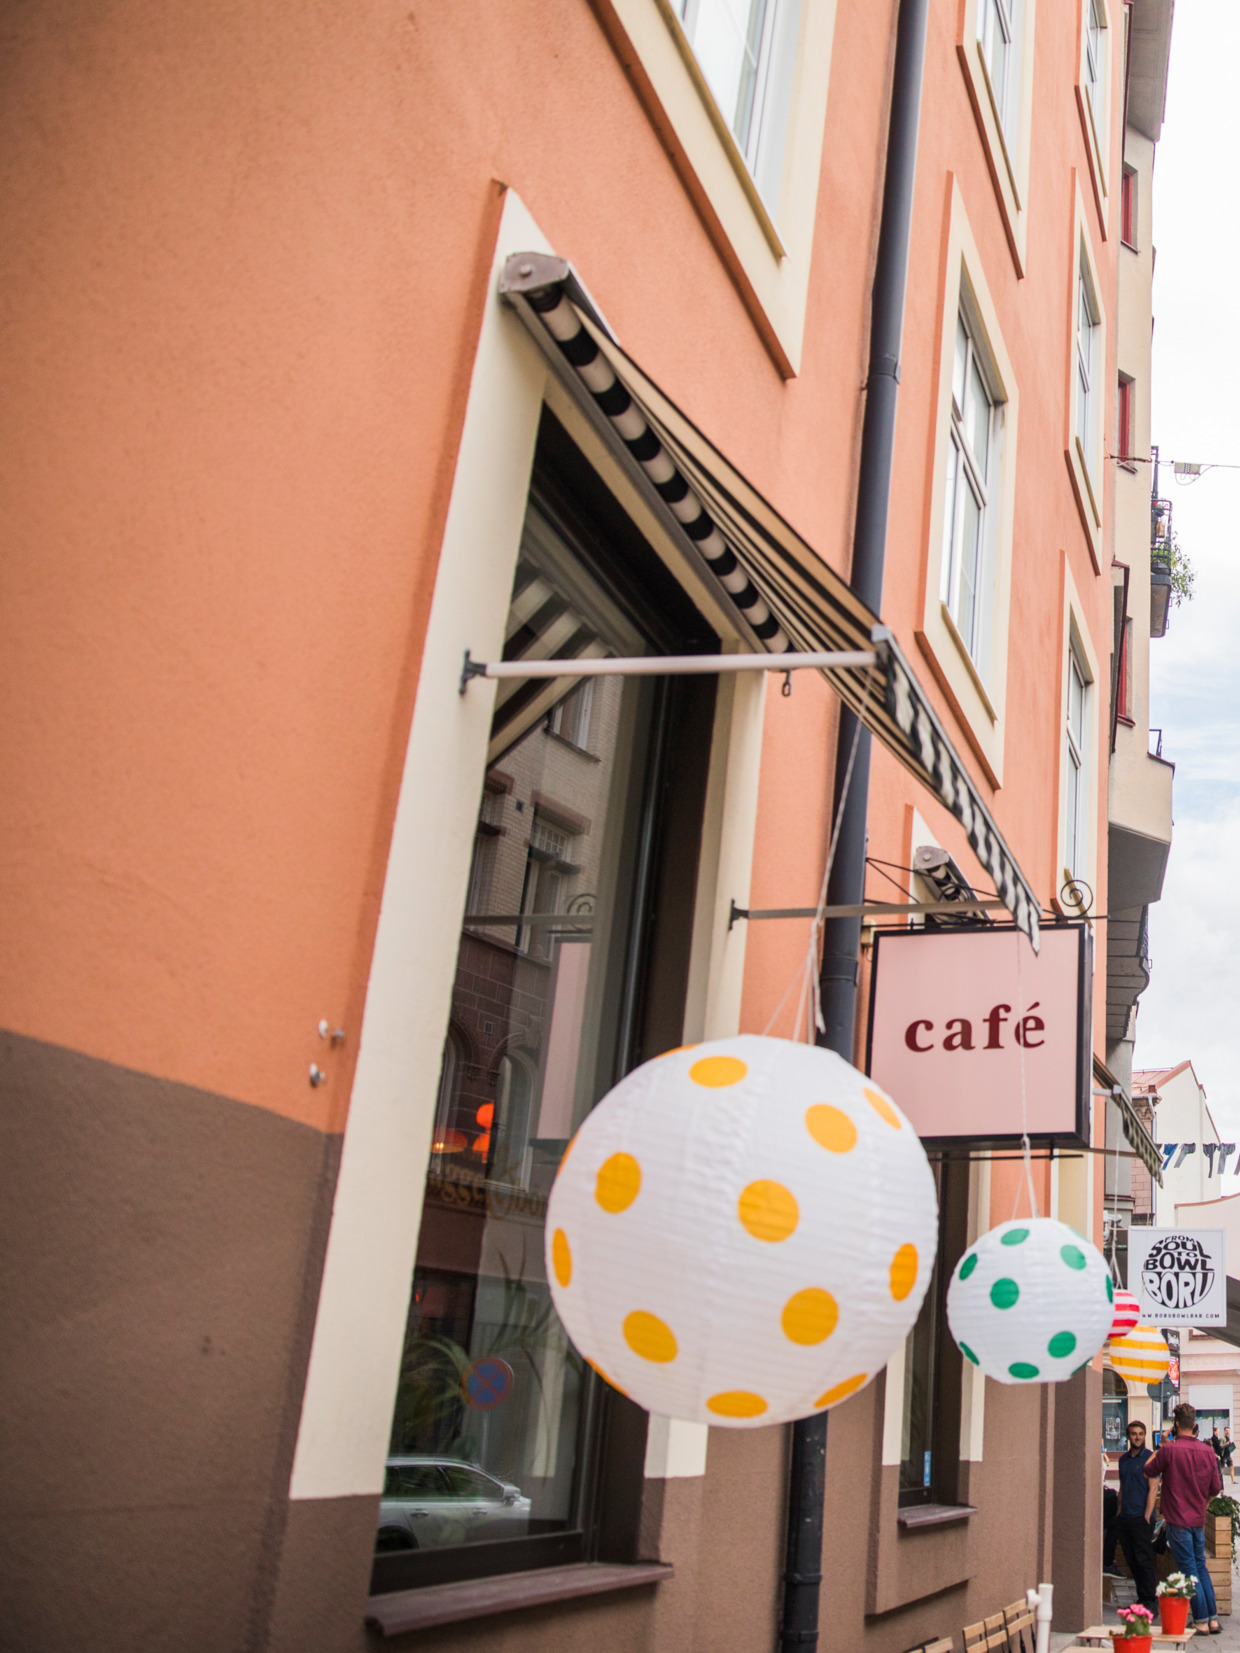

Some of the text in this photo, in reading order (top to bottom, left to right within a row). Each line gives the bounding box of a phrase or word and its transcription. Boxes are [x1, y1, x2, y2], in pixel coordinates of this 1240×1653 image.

[904, 1001, 1045, 1053] café
[1165, 1235, 1195, 1244] FROM
[1148, 1240, 1212, 1259] SOUL
[1175, 1250, 1198, 1258] TO
[1143, 1251, 1215, 1271] BOWL
[1141, 1271, 1215, 1309] BORU
